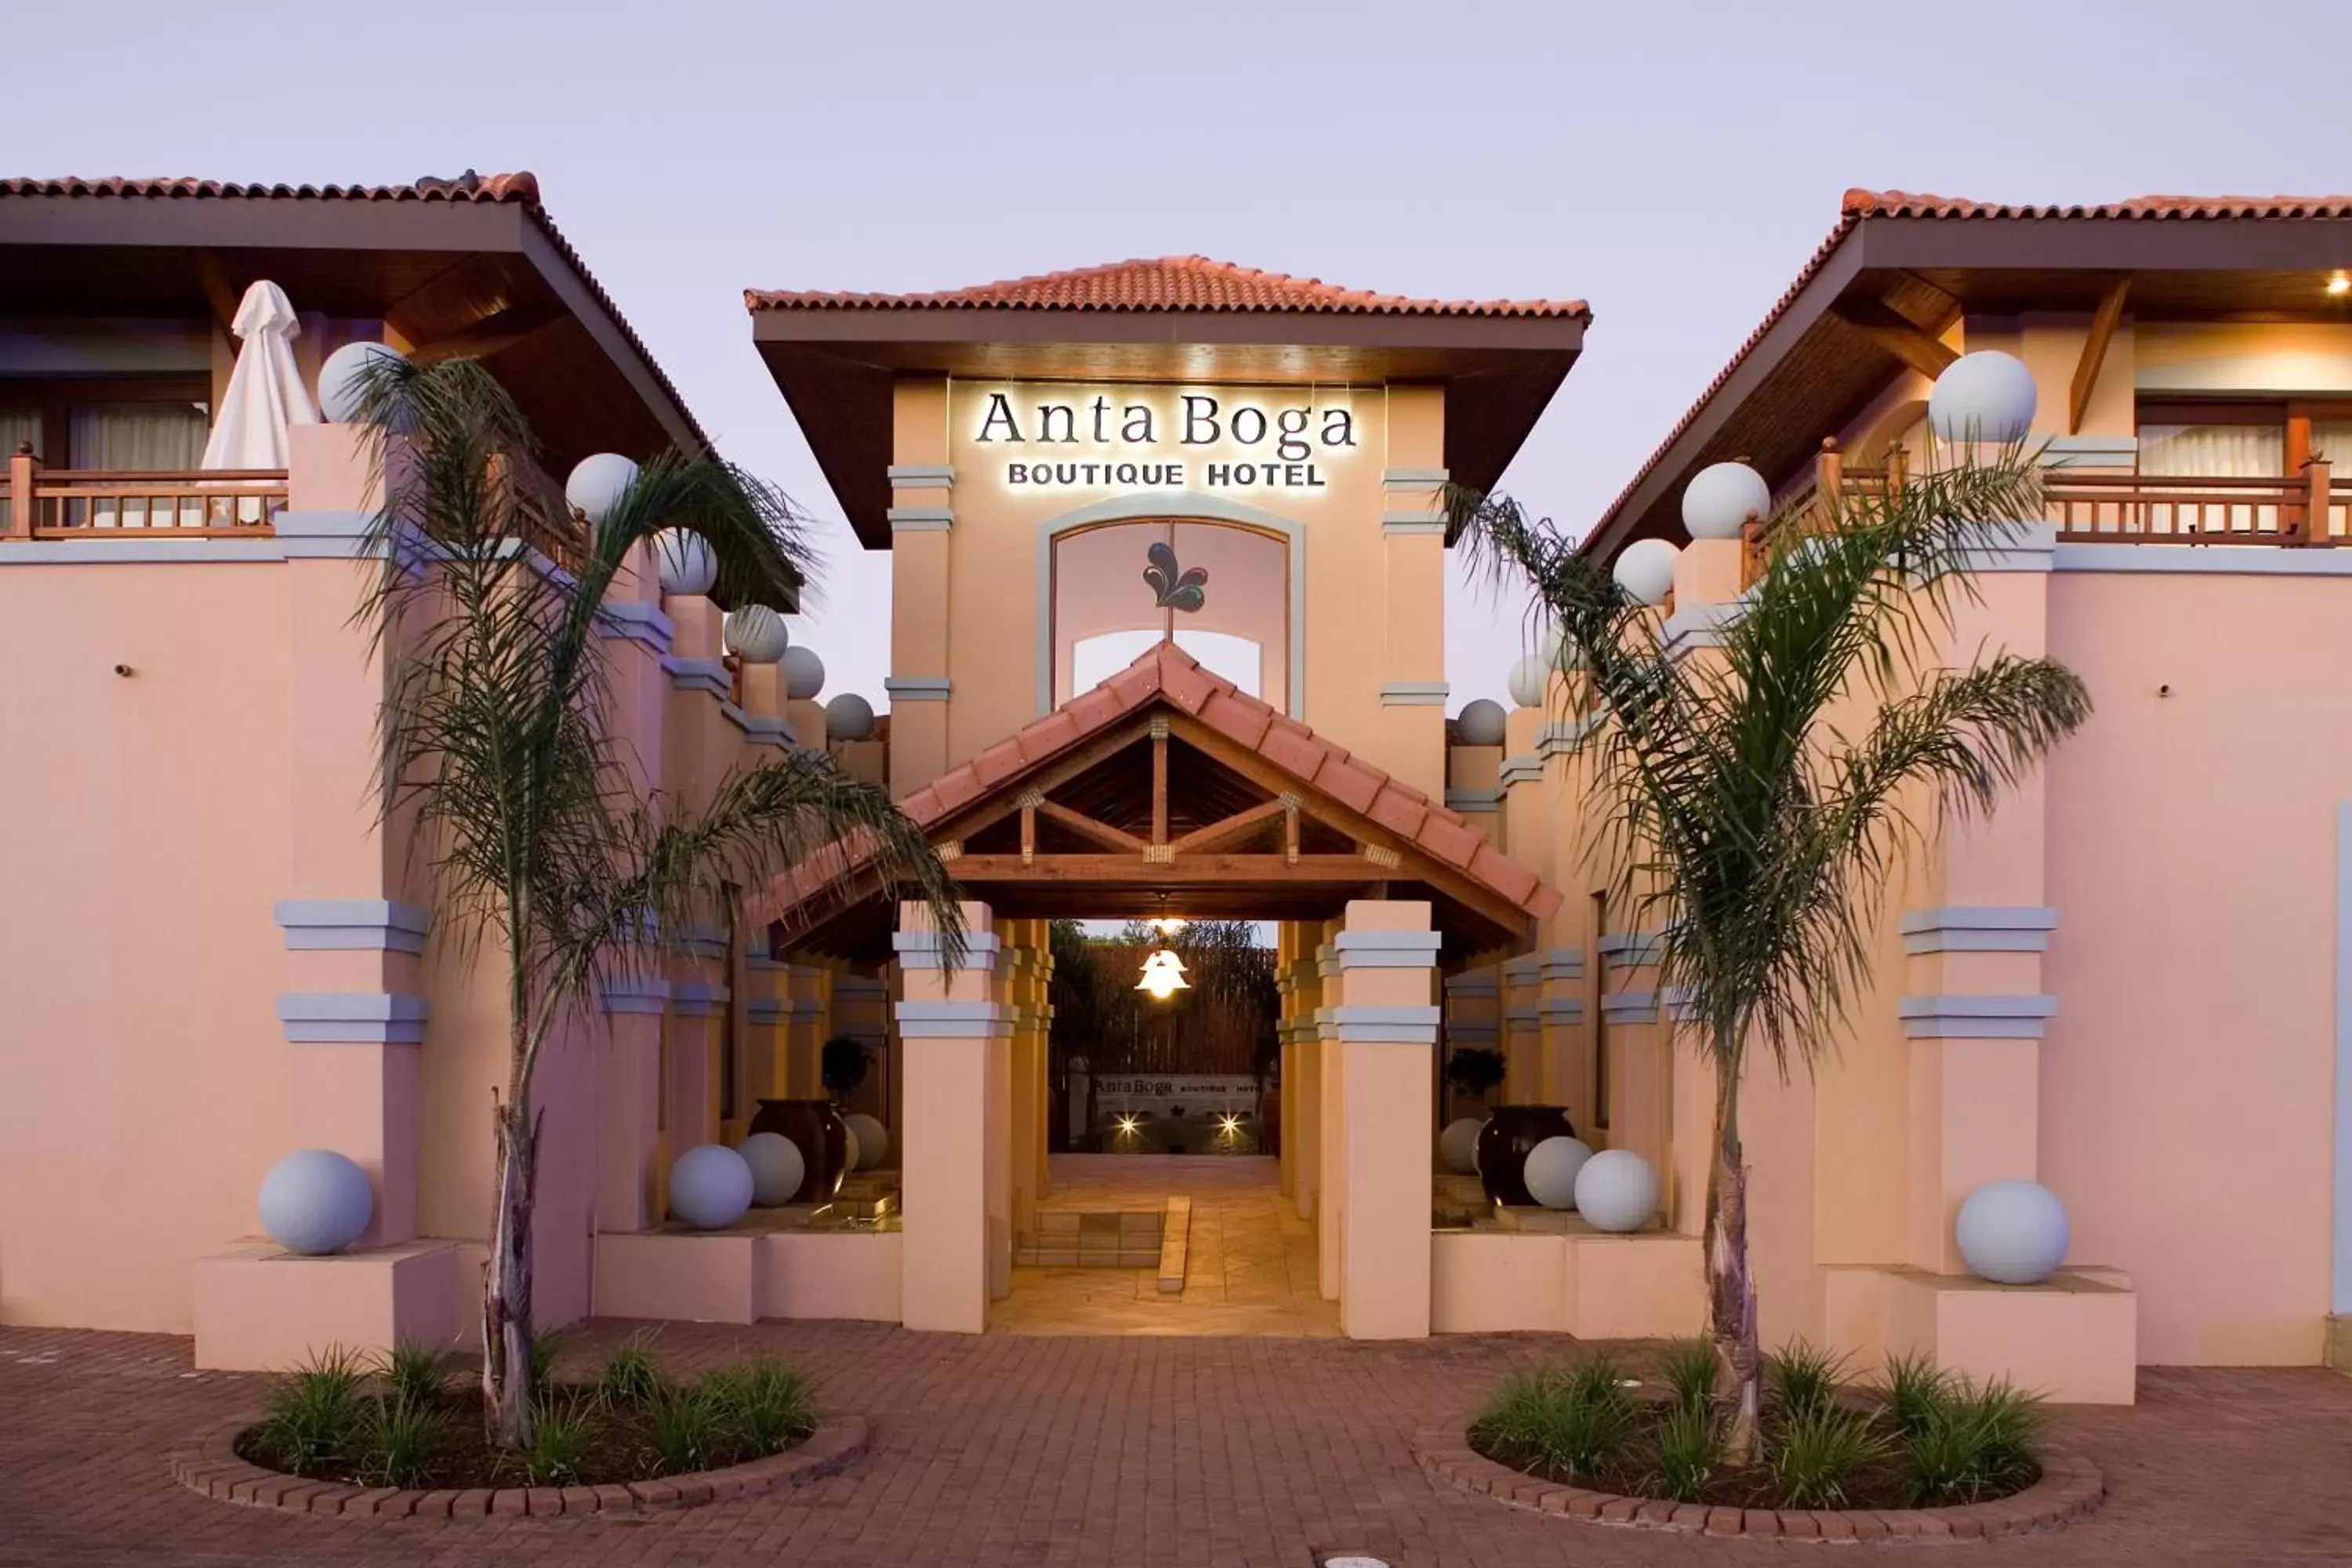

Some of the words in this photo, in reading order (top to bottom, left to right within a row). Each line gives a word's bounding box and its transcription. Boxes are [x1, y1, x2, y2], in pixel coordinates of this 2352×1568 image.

[975, 393, 1157, 444] Anta
[1180, 395, 1356, 462] Boga
[1008, 463, 1183, 485] BOUTIQUE
[1208, 463, 1325, 486] HOTEL
[1134, 1079, 1173, 1096] Boga
